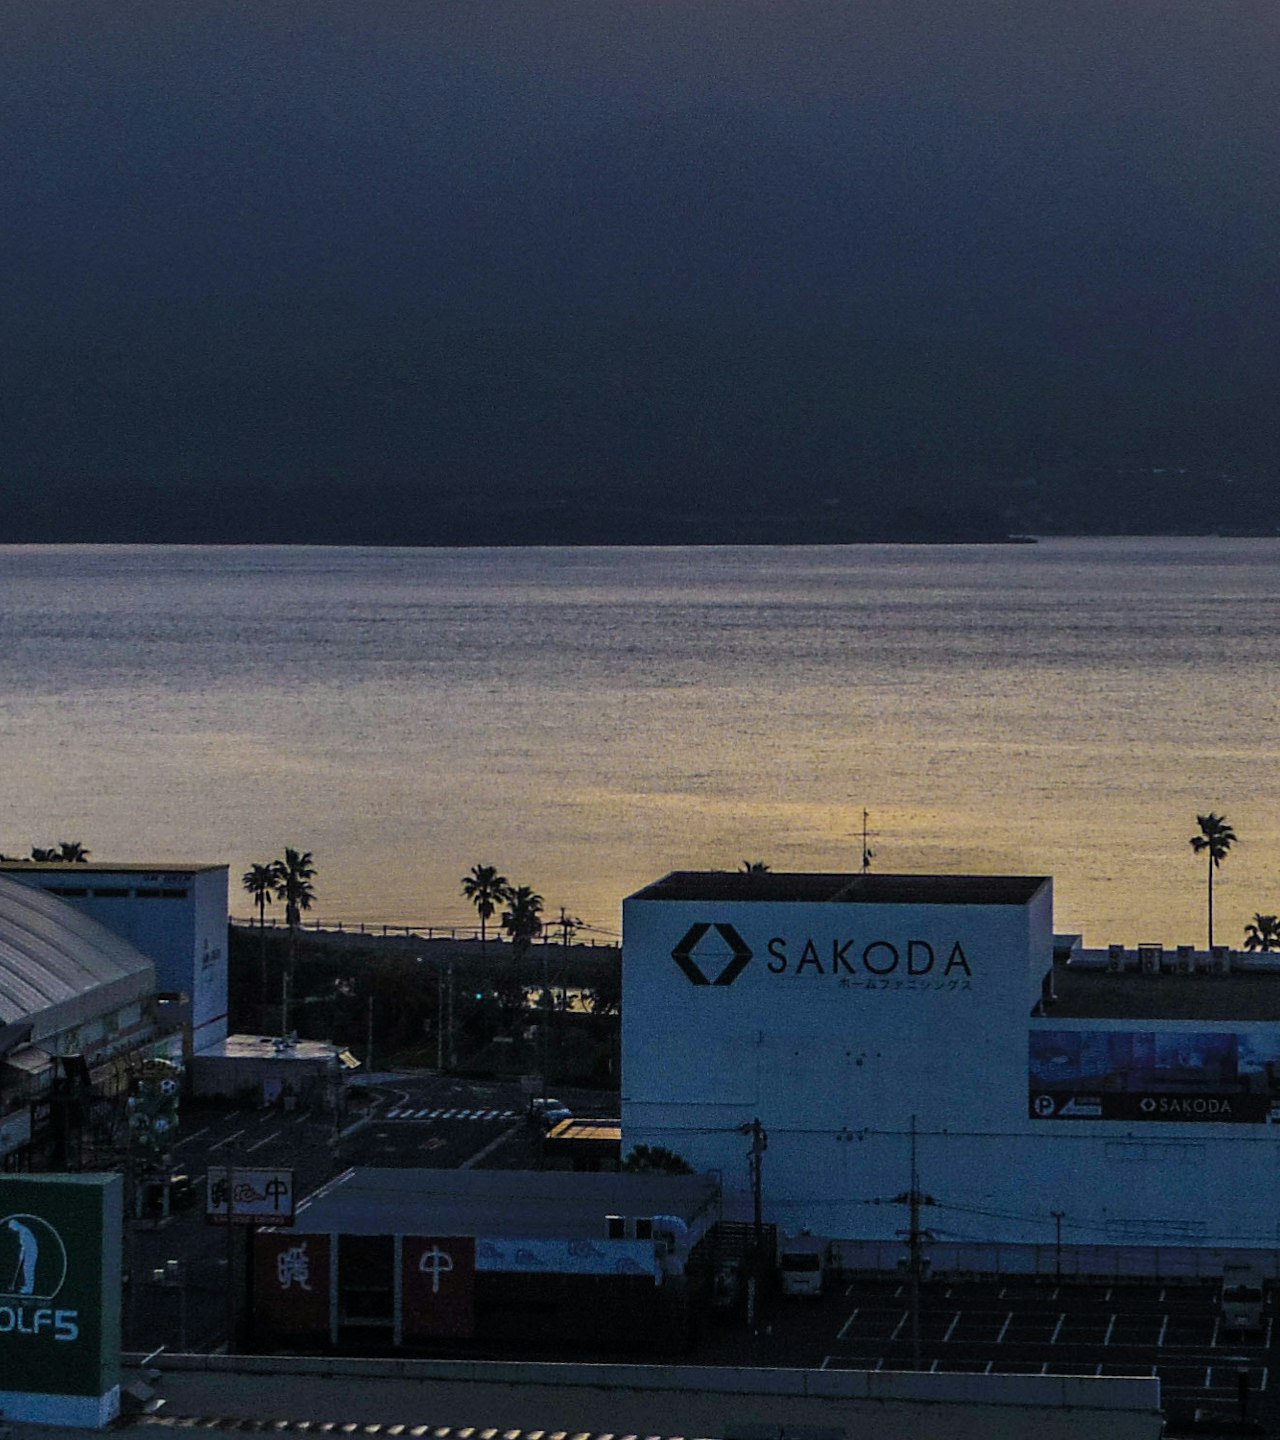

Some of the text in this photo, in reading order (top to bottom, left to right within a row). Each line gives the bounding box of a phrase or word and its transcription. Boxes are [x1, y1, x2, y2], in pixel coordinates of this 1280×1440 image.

[767, 937, 972, 976] SAKODA
[1159, 1097, 1233, 1114] SAKODA
[266, 1175, 289, 1210] 中
[419, 1244, 454, 1294] 中
